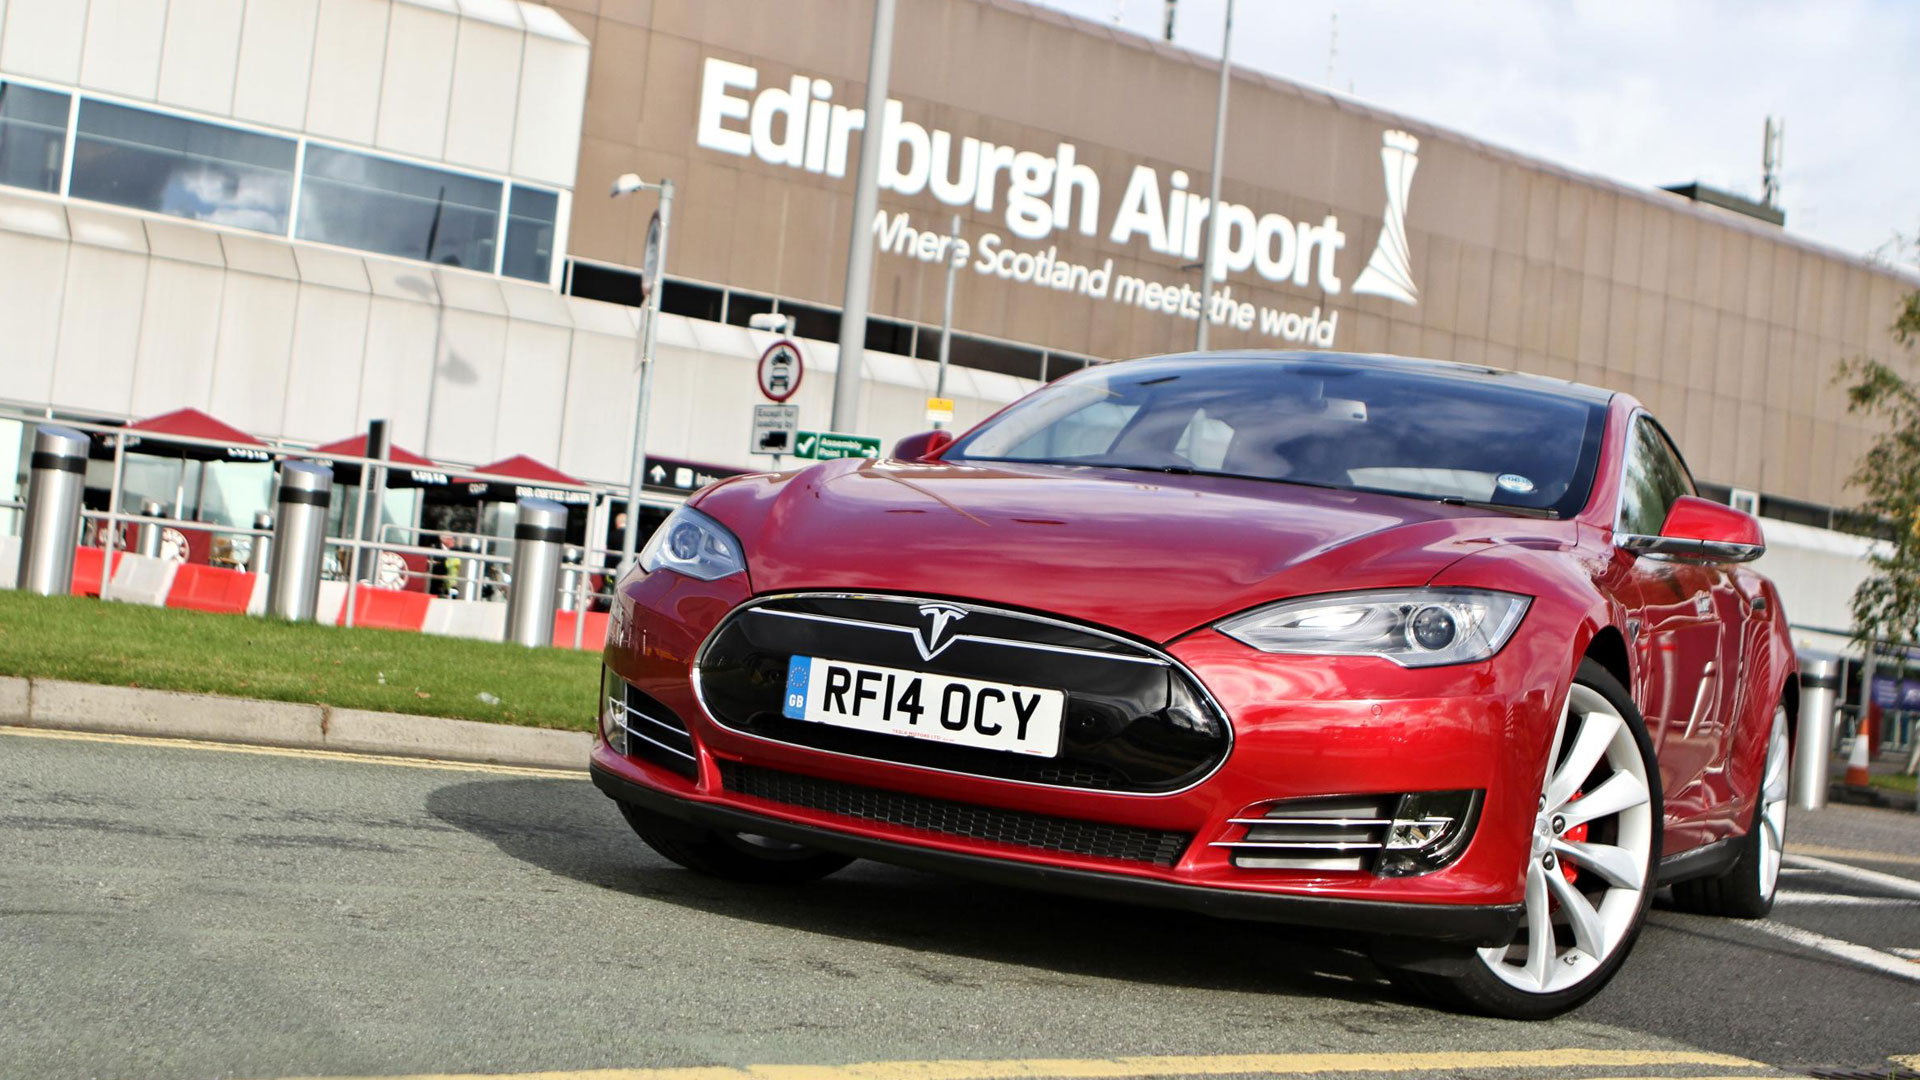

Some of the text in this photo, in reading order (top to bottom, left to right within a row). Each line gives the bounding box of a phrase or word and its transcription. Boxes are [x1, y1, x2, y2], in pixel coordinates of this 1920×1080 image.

[696, 56, 1346, 295] Edinburgh Airport
[973, 231, 1114, 300] Scotland
[1113, 272, 1202, 321] meets
[1209, 285, 1256, 331] the
[1259, 304, 1339, 348] world
[819, 447, 841, 458] Point
[820, 437, 863, 450] Assembly
[787, 693, 805, 709] GB
[822, 665, 1042, 741] RF14 OCY
